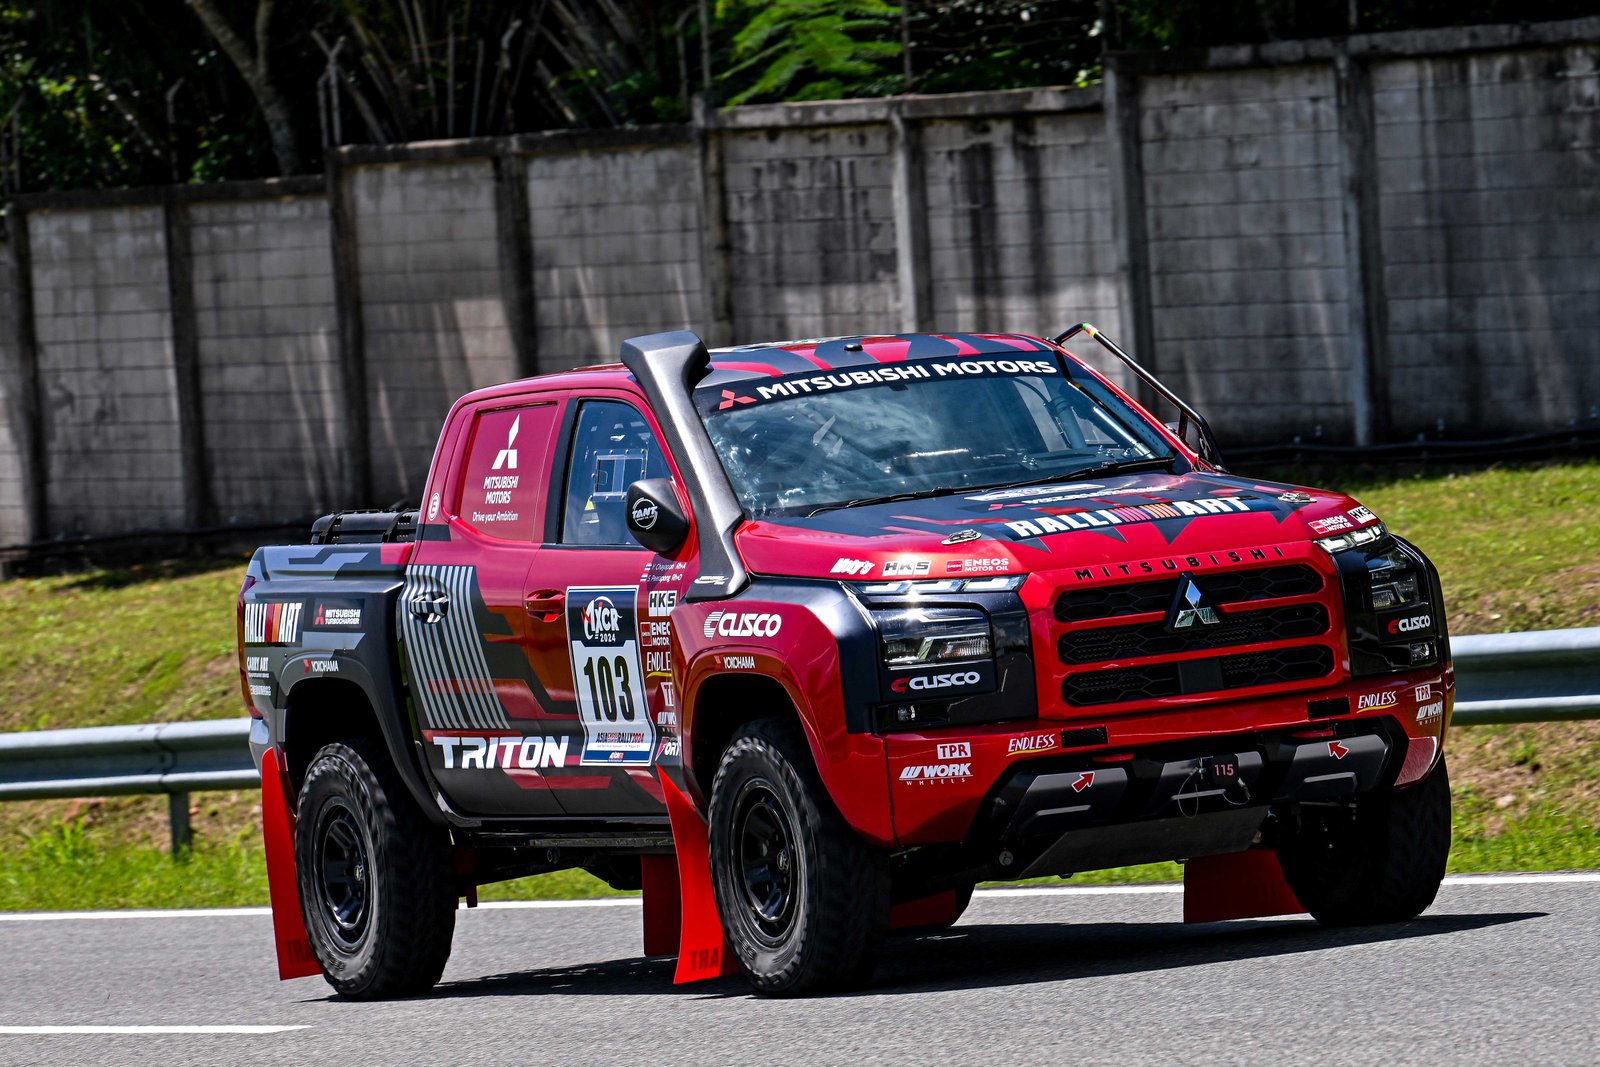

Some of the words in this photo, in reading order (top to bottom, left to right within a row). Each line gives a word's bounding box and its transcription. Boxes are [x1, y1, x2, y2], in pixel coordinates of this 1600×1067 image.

[755, 363, 929, 400] MITSUBISHI
[930, 359, 1058, 378] MOTORS
[483, 475, 519, 490] MITSUBISHI
[485, 491, 511, 505] MOTORS
[472, 511, 483, 522] Drive
[484, 512, 496, 524] your
[496, 511, 519, 521] Ambition
[631, 505, 658, 519] TANT
[1007, 508, 1124, 539] RALLI
[1173, 496, 1255, 518] ART
[1319, 515, 1348, 527] ENEOS
[964, 558, 1009, 567] ENEOS
[1073, 545, 1285, 582] MITSUBISHI
[649, 591, 676, 608] HKS
[325, 608, 361, 618] MITSUBISHI
[245, 603, 268, 643] RALLI
[278, 602, 302, 643] ART
[325, 617, 360, 625] TURBOCHARGER
[717, 612, 782, 638] CUSCO
[1398, 614, 1431, 632] CUSCO
[600, 633, 616, 643] 2024
[652, 636, 670, 646] MOTOR
[260, 656, 269, 671] ART
[311, 660, 339, 672] YOKOHAMA
[723, 655, 756, 670] YOKOHAMA
[909, 671, 981, 690] CUSCO
[583, 655, 635, 722] 103
[1417, 686, 1430, 700] TPR
[1357, 690, 1398, 709] ENDLESS
[1007, 733, 1056, 752] ENDLESS
[433, 735, 570, 769] TRITON
[939, 743, 969, 758] TPR
[923, 762, 972, 778] WORK
[1214, 763, 1235, 777] 115
[906, 777, 966, 786] WHEELS
